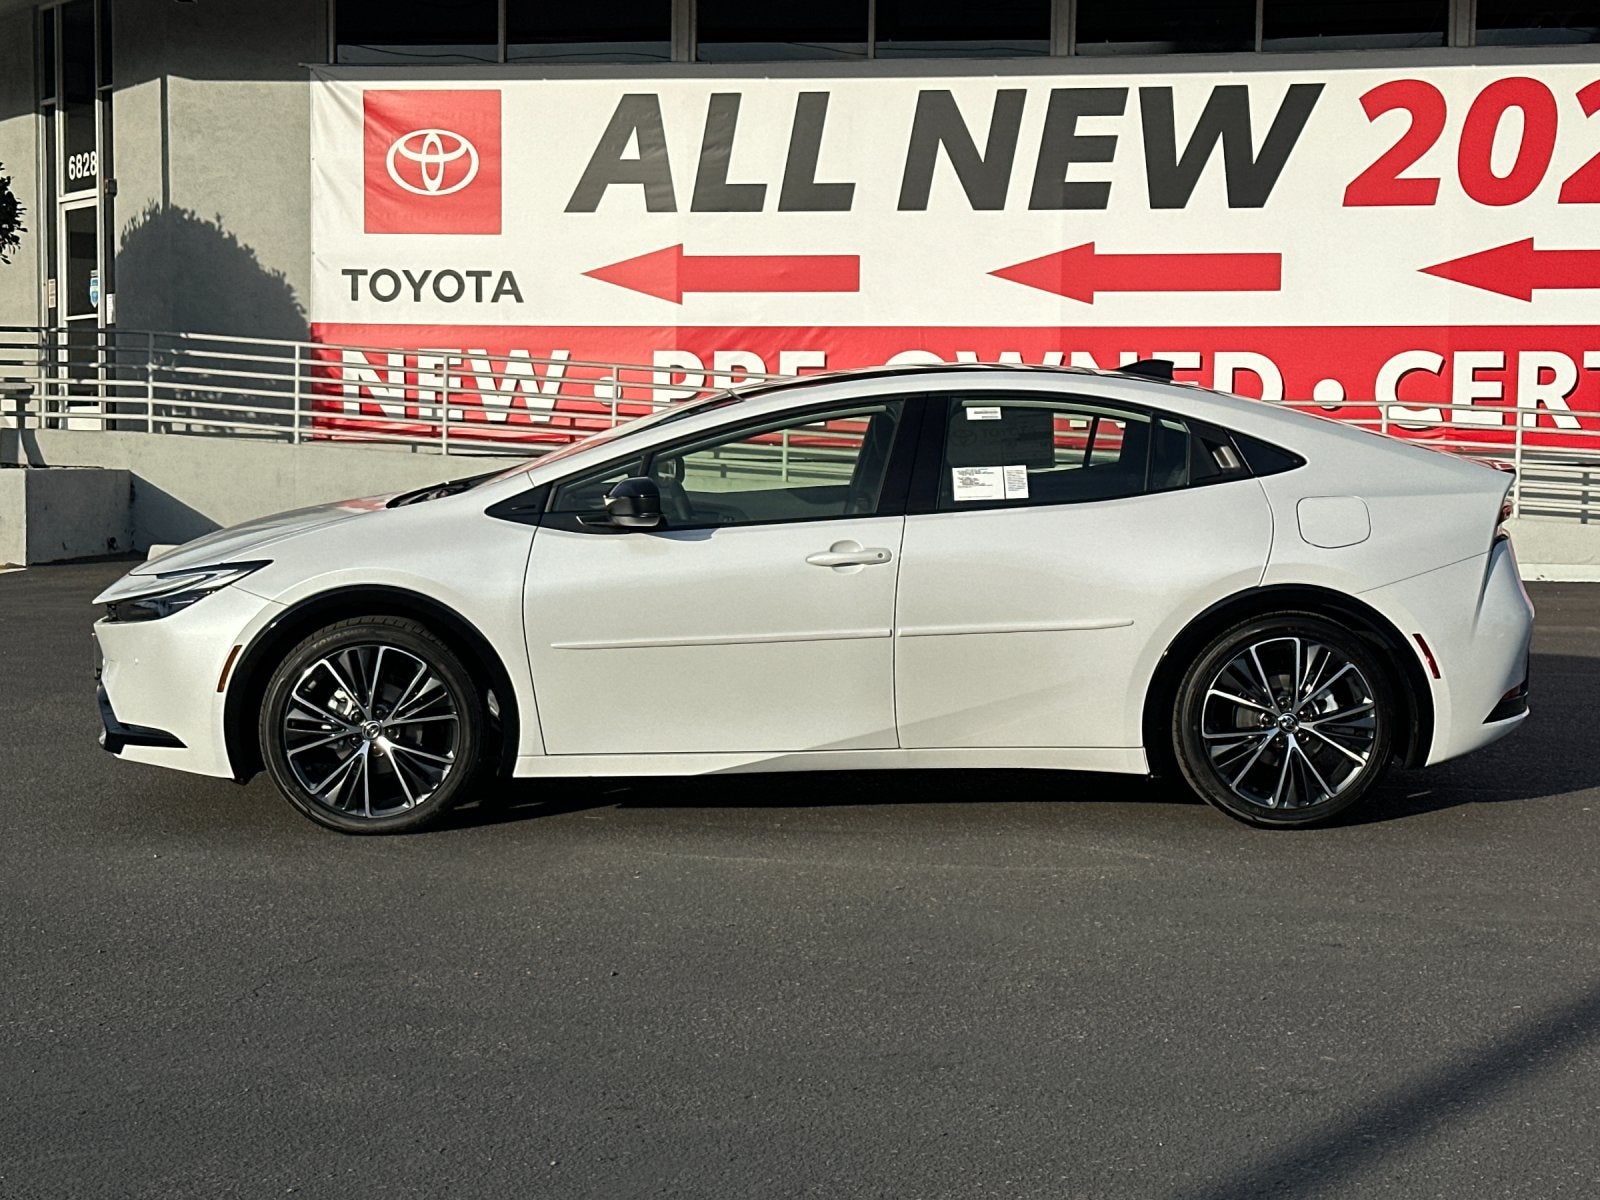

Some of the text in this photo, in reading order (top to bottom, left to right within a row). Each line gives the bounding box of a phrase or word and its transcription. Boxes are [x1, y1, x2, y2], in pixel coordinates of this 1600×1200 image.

[69, 151, 97, 180] 6828
[564, 91, 856, 213] ALL
[897, 83, 1326, 211] NEW
[342, 269, 523, 303] TOYOTA
[342, 348, 570, 424] NEW
[1375, 350, 1600, 429] CER
